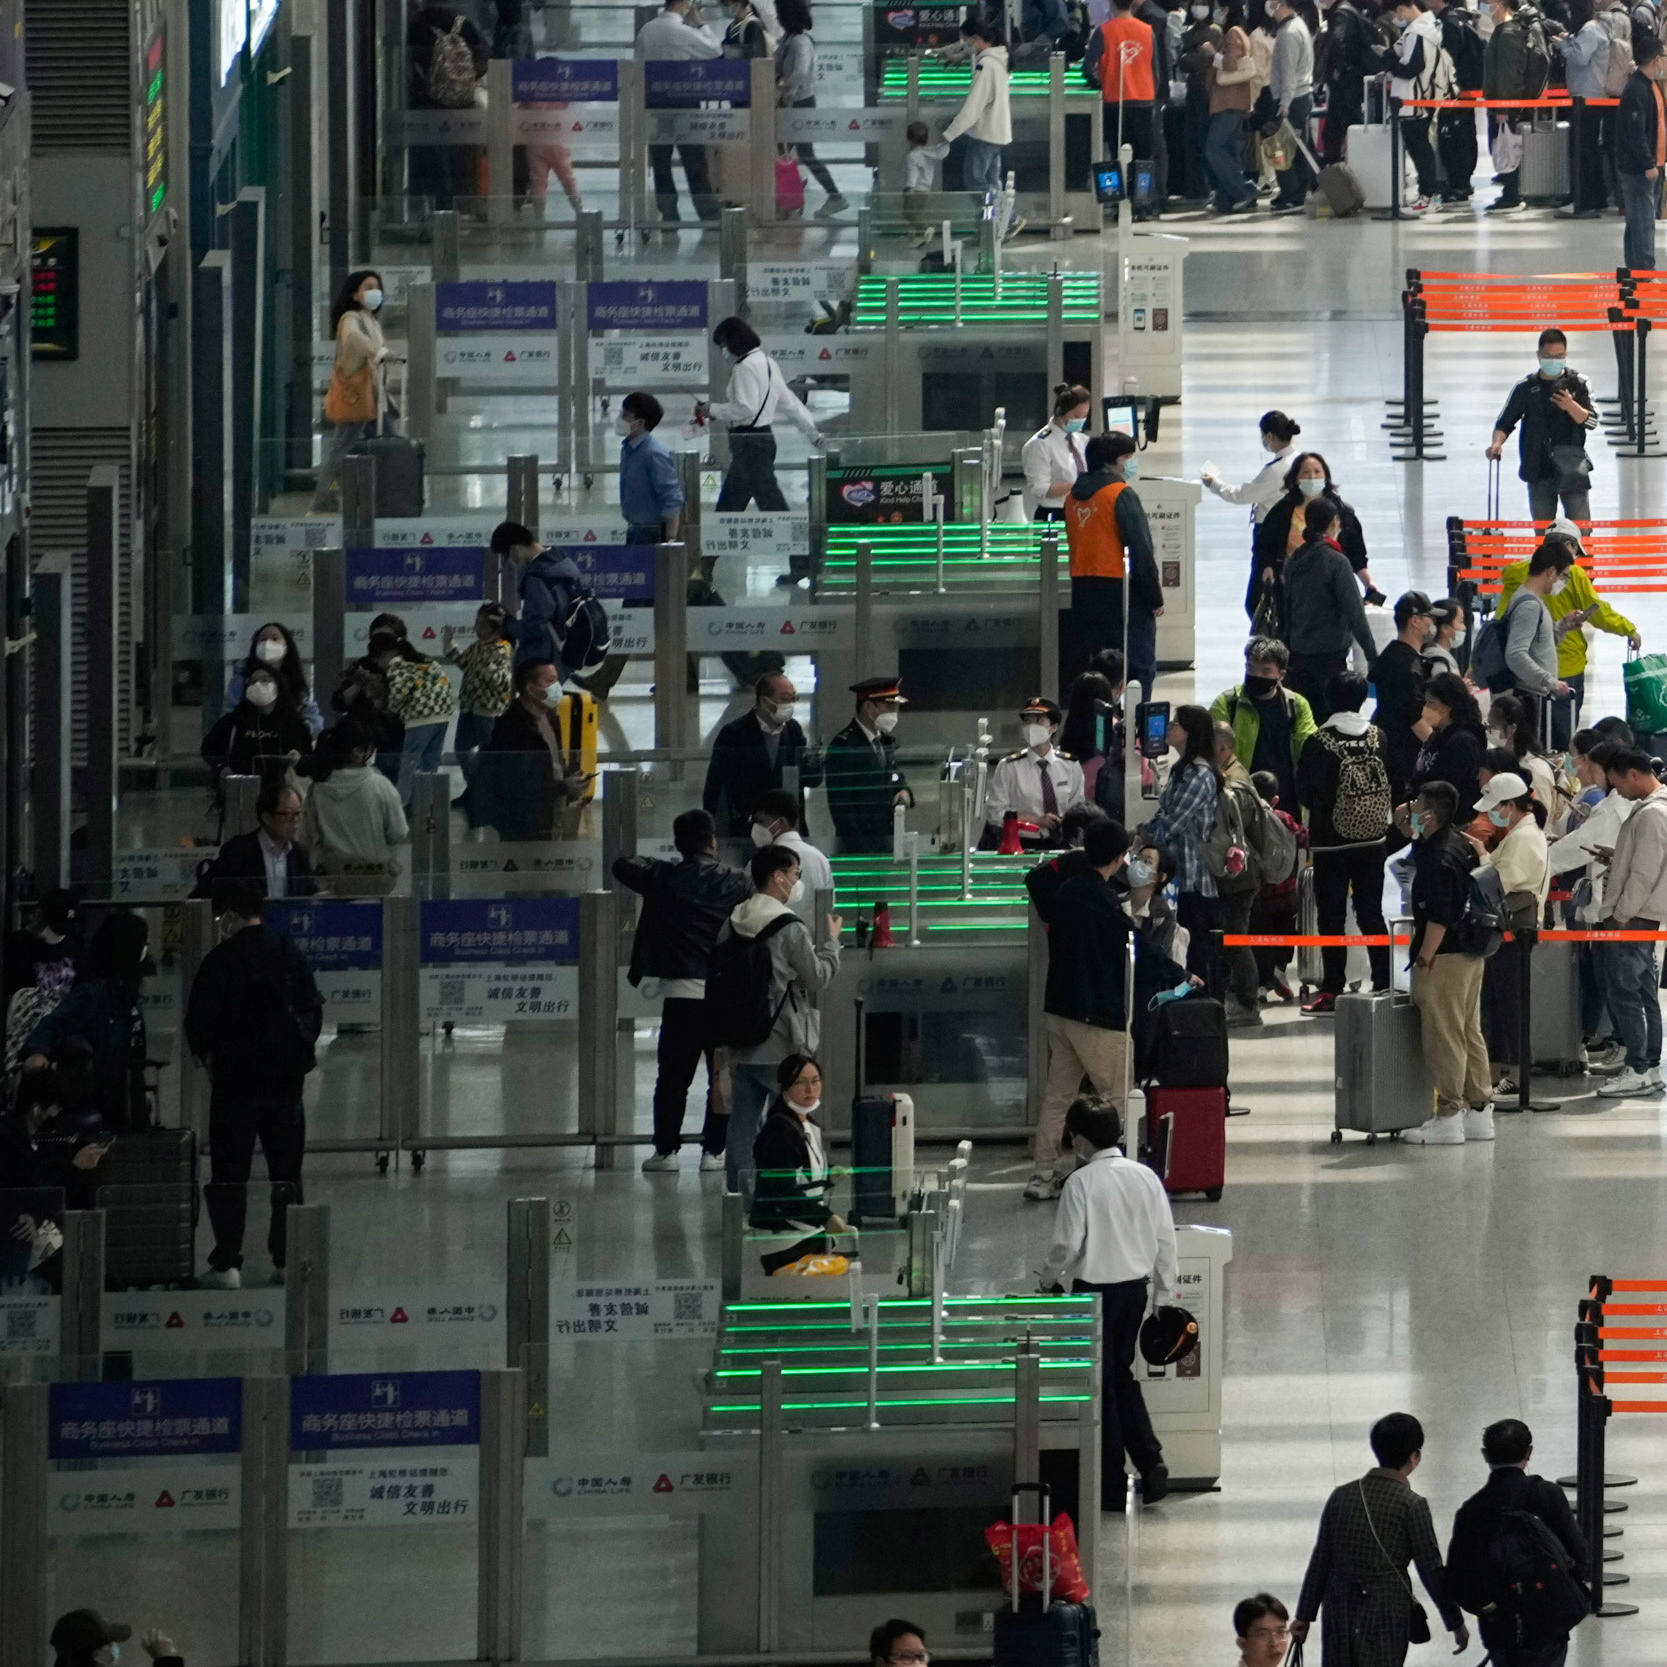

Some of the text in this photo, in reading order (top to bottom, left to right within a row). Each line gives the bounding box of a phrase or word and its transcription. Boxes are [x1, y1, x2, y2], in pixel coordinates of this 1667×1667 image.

[430, 932, 568, 948] 商务座快捷检票通道
[487, 988, 541, 999] 诚信友善
[516, 1001, 569, 1013] 文明出行
[60, 1417, 229, 1439] 商务座快捷检票通道
[302, 1409, 469, 1433] 商务座快捷检票通道
[680, 1473, 732, 1485] 广发银行
[181, 1489, 229, 1503] 广发银行
[369, 1484, 434, 1501] 诚信友善
[402, 1499, 469, 1516] 文明出行
